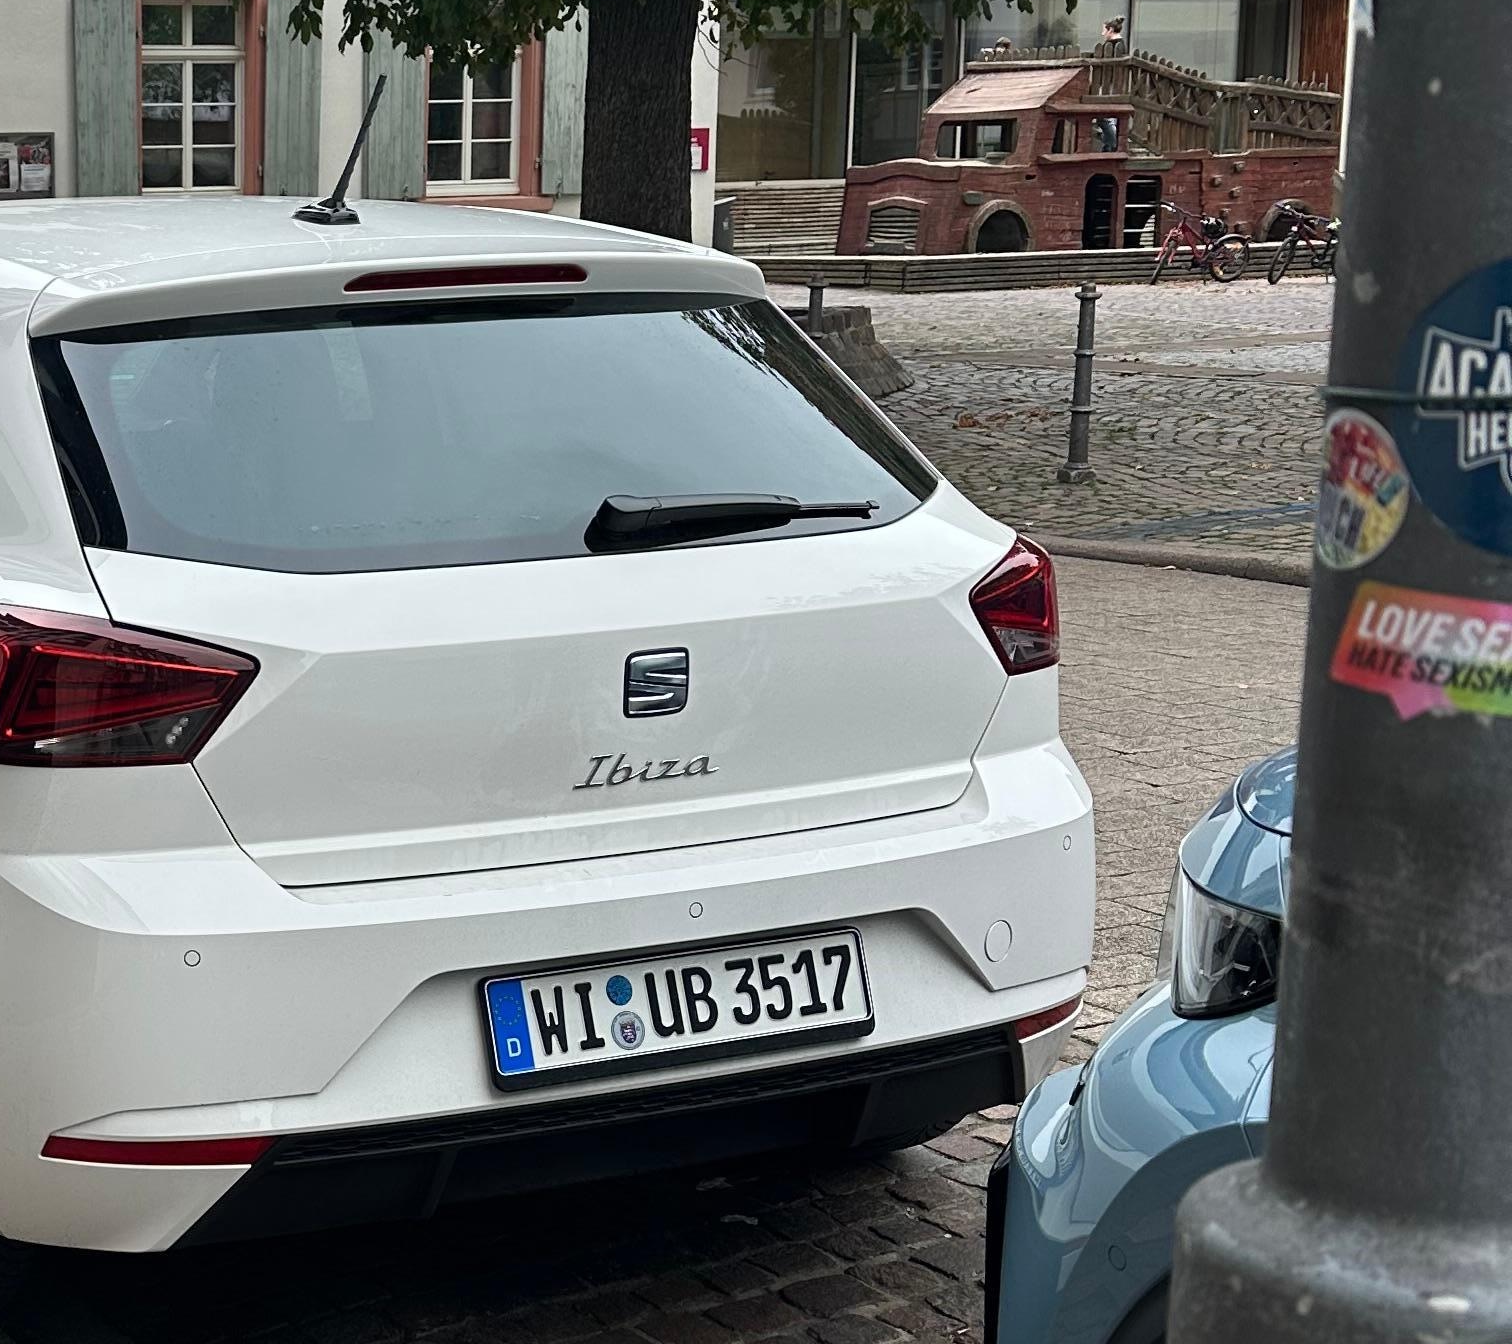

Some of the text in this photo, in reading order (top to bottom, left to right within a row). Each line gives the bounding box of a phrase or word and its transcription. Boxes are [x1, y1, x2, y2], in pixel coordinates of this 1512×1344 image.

[1468, 411, 1512, 456] HE
[1358, 601, 1455, 656] LOVE
[1349, 641, 1411, 679] HATE
[572, 752, 720, 790] Ibiza
[530, 944, 851, 1056] WI UB 3517
[506, 1037, 522, 1058] D
